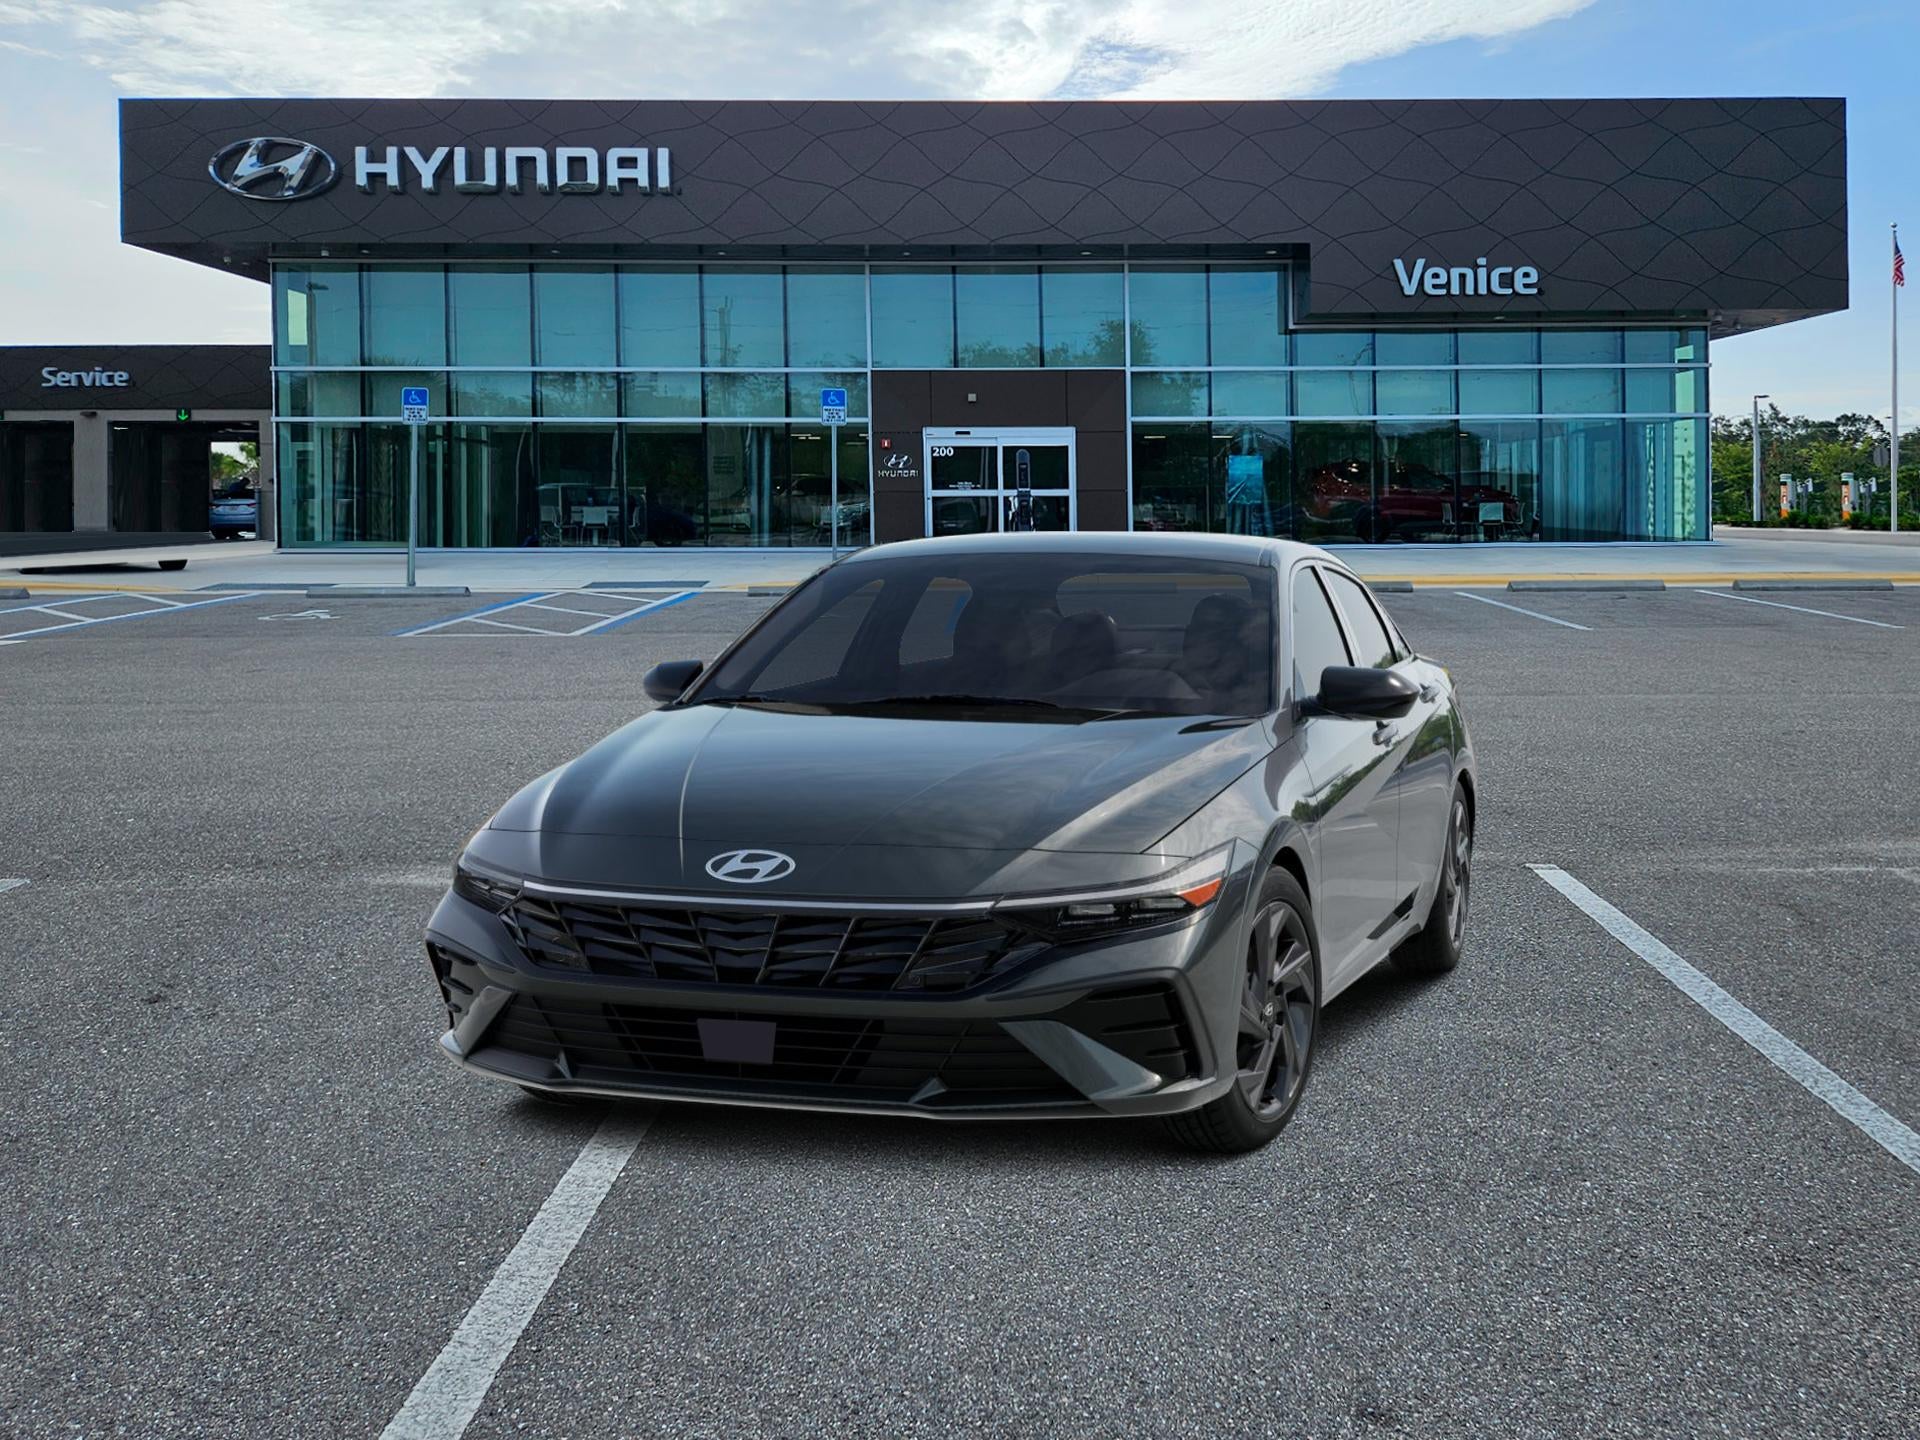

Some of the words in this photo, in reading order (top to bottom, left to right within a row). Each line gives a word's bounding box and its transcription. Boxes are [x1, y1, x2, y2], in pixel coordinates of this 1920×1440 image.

[354, 145, 672, 194] HYUNDAI
[1392, 256, 1539, 296] Venice
[41, 366, 130, 387] Service
[932, 446, 954, 457] 200
[877, 469, 919, 478] HYUNDAI
